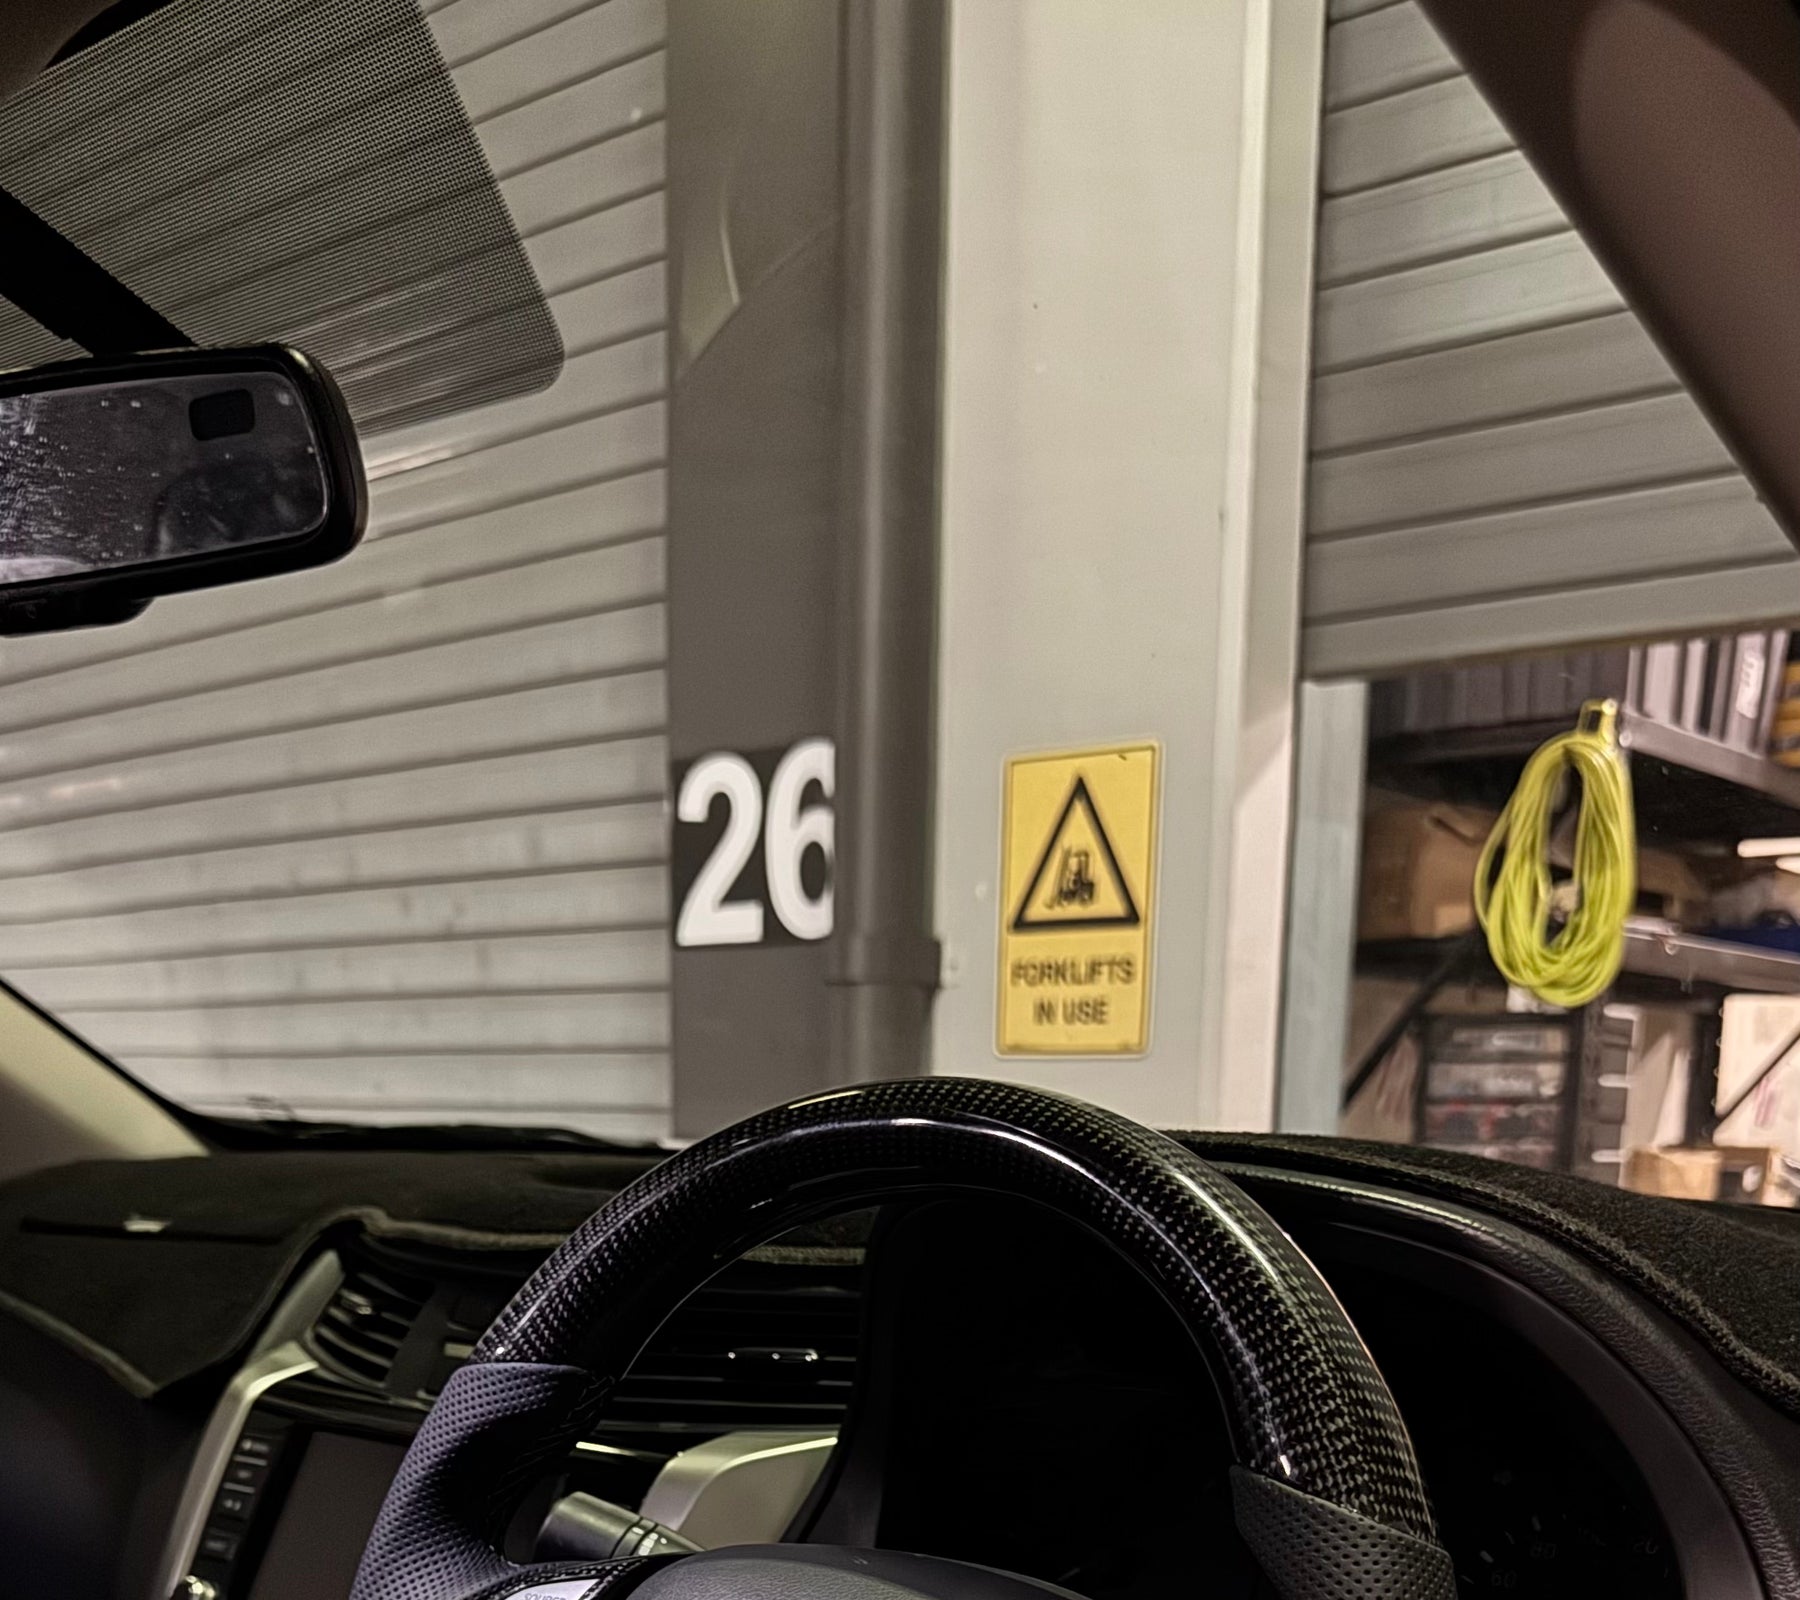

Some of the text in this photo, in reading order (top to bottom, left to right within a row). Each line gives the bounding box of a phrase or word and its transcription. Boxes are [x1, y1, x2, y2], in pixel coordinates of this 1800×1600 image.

[677, 737, 836, 947] 26
[1010, 954, 1136, 987] FORKLIFTS
[1033, 995, 1109, 1026] IN USE
